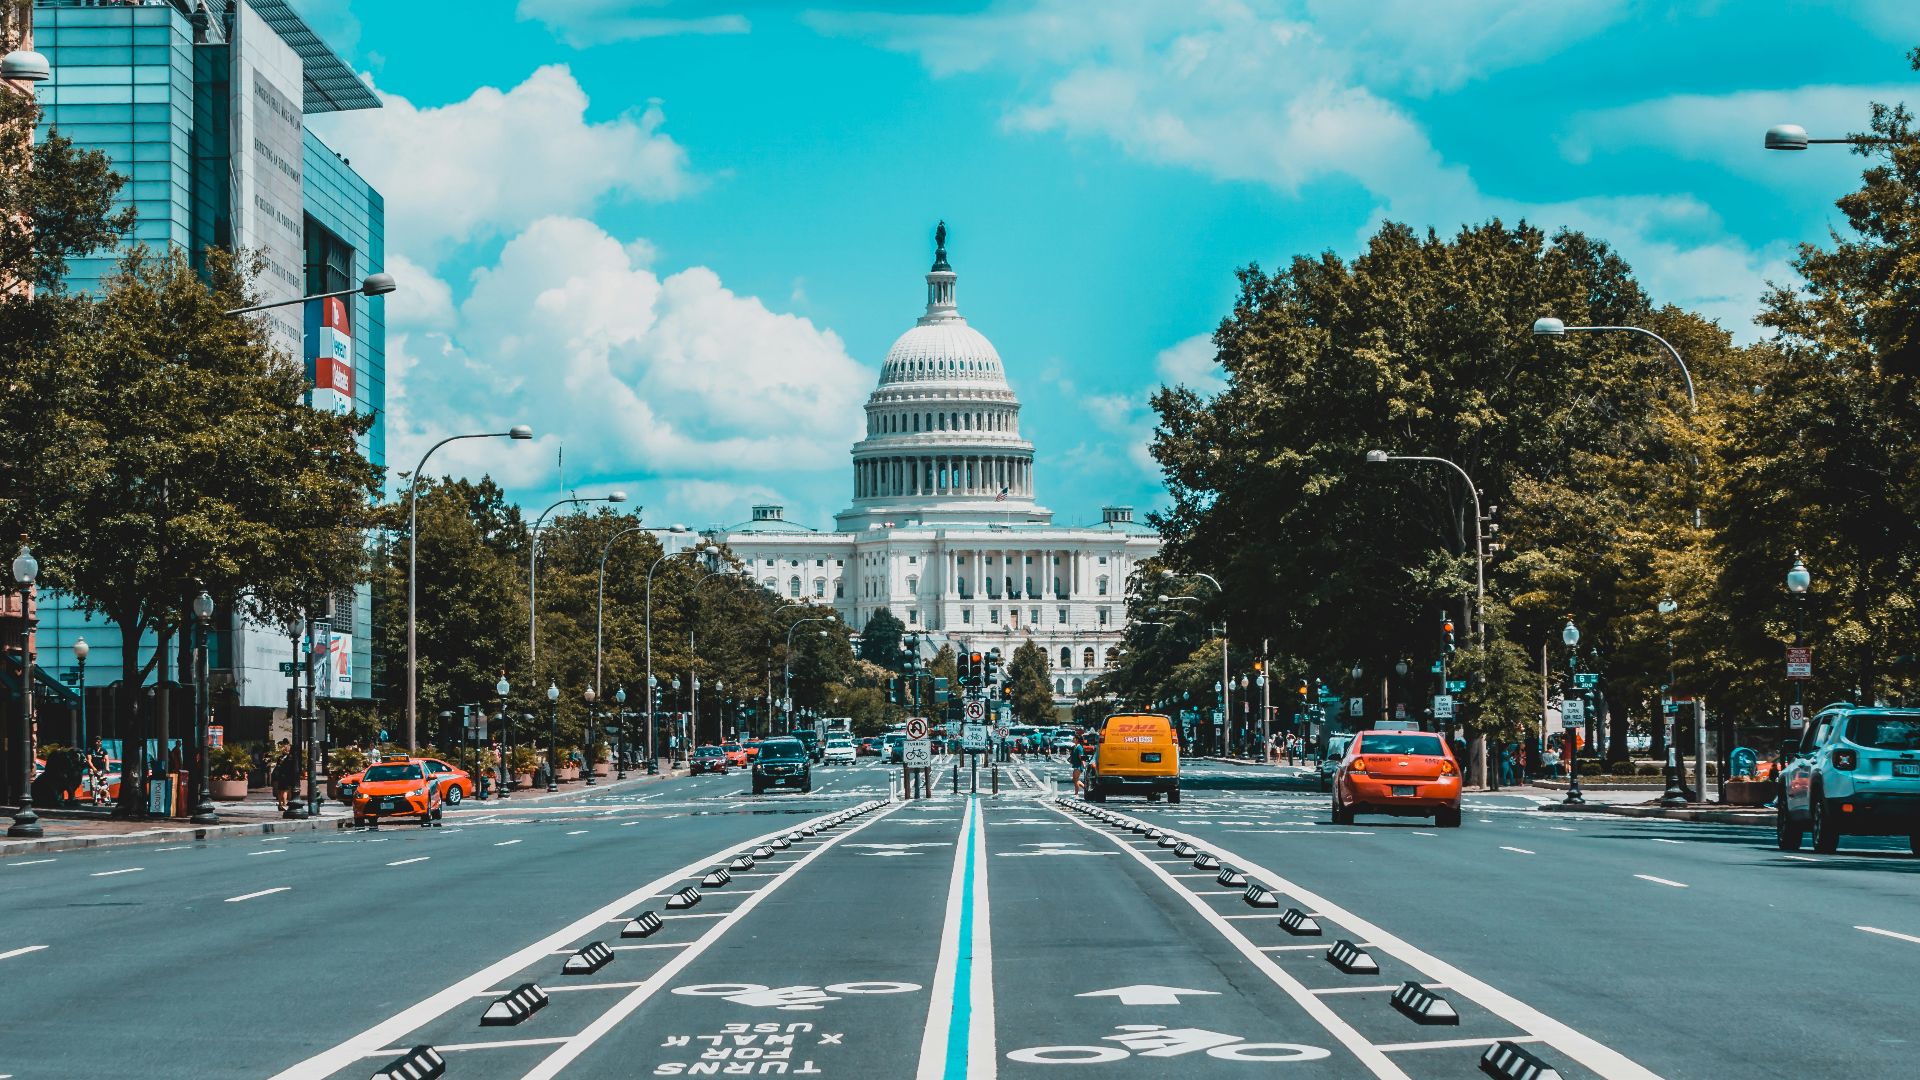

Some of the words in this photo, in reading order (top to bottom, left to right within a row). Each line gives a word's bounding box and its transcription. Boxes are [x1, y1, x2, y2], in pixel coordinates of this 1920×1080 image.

[284, 663, 291, 671] 6
[1579, 675, 1585, 683] 6
[1118, 724, 1156, 732] DHL
[154, 782, 162, 809] POLITICO
[720, 1022, 813, 1033] USE
[660, 1033, 796, 1047] WALK
[817, 1033, 844, 1045] X
[700, 1047, 793, 1060] FOR
[653, 1060, 822, 1075] TURNS
